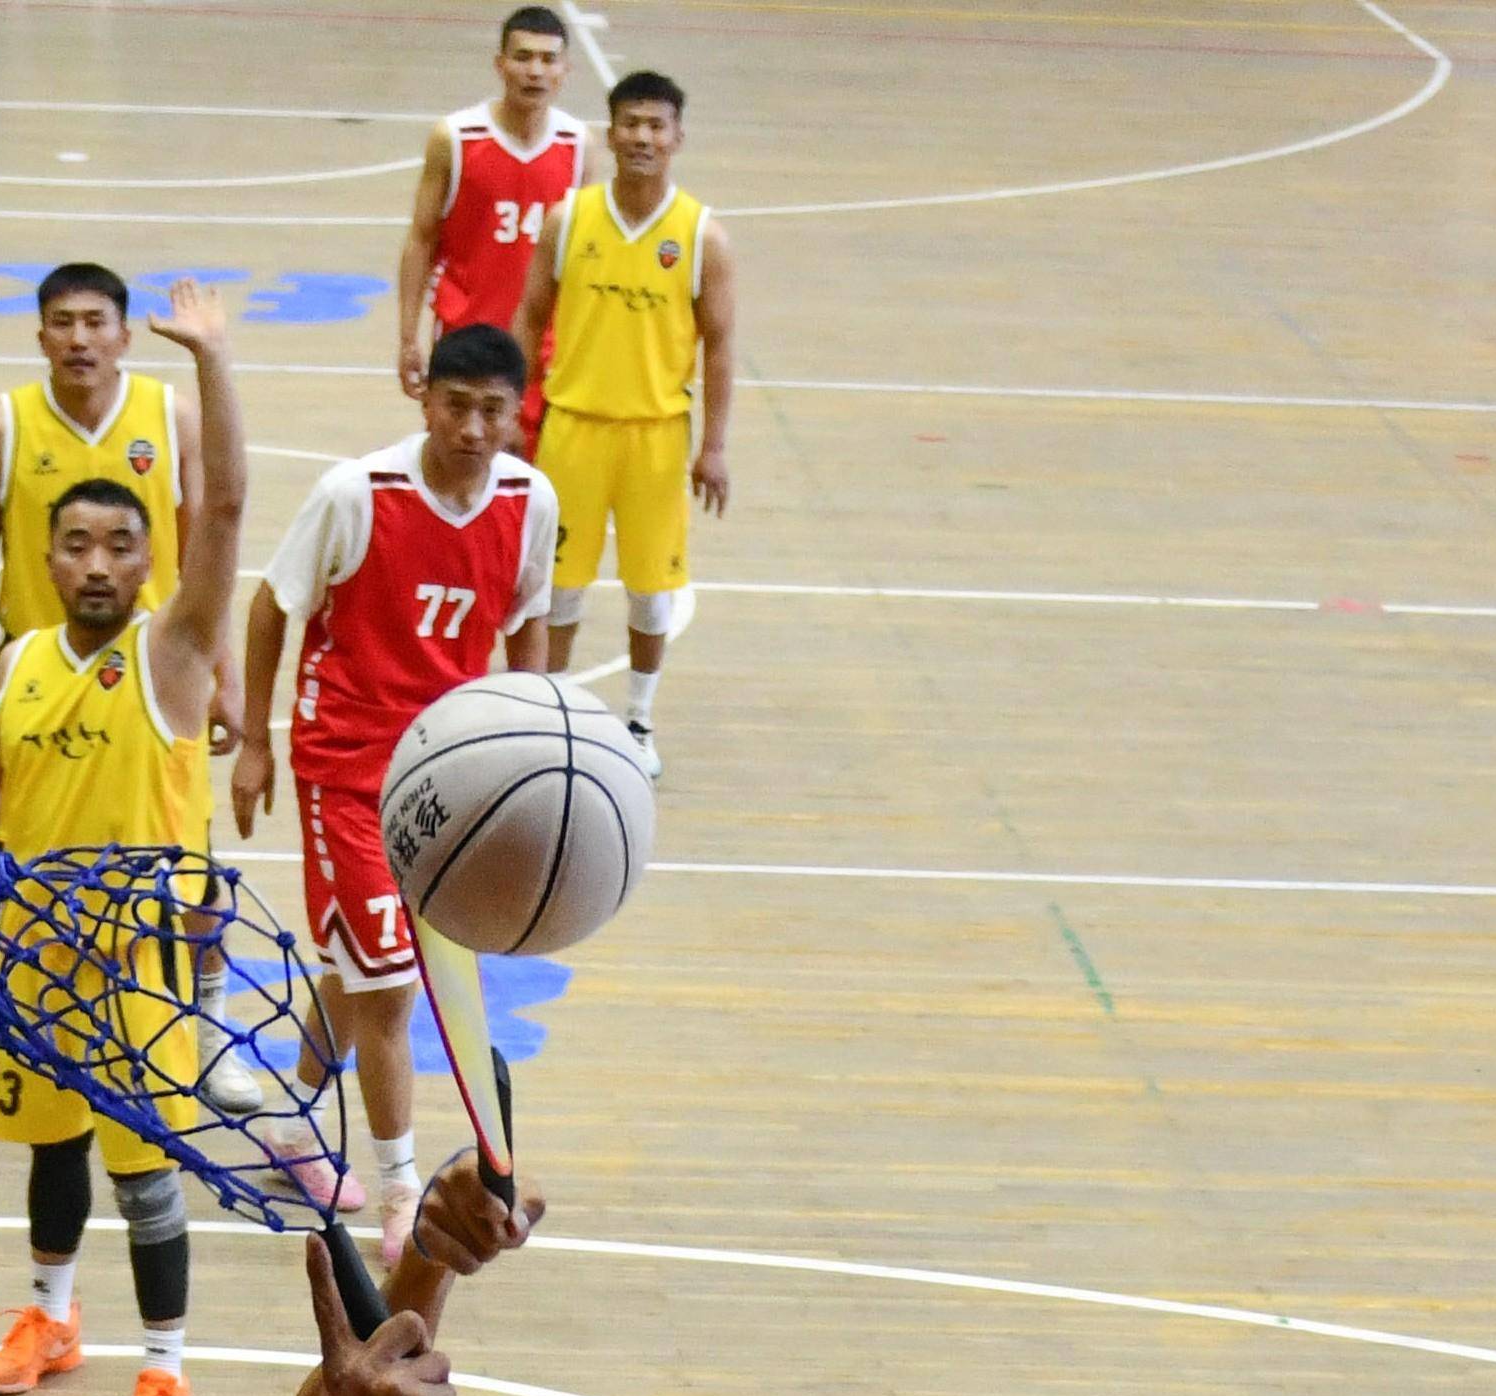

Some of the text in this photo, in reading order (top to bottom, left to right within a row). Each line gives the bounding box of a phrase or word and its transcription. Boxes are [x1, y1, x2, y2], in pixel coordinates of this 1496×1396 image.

[493, 200, 546, 245] 34
[415, 583, 476, 639] 77
[365, 893, 412, 950] 7
